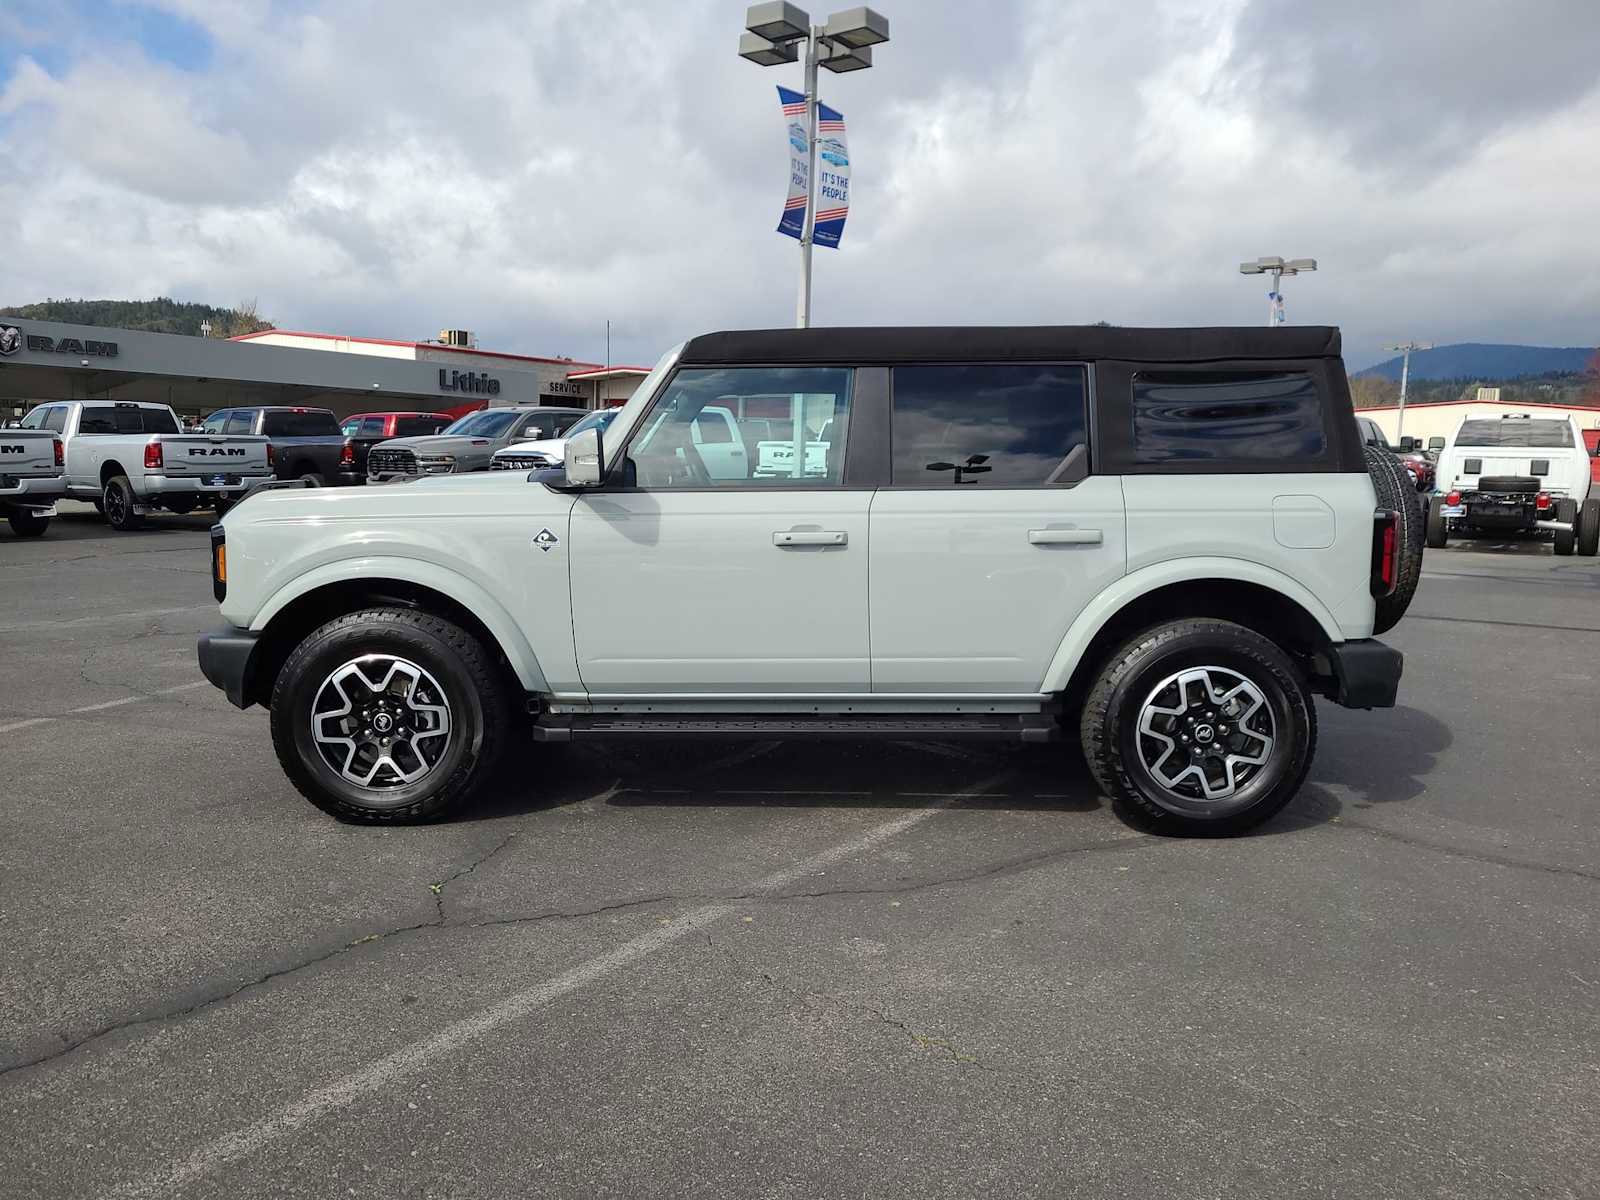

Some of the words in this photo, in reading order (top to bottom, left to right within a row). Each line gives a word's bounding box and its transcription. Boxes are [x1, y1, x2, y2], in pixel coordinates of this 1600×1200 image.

[821, 172, 836, 185] IT'S
[836, 175, 849, 189] THE
[822, 185, 847, 202] PEOPLE
[27, 334, 119, 357] RAM
[439, 368, 501, 394] Lithia
[550, 382, 582, 393] SERVICE
[188, 448, 246, 456] RAM
